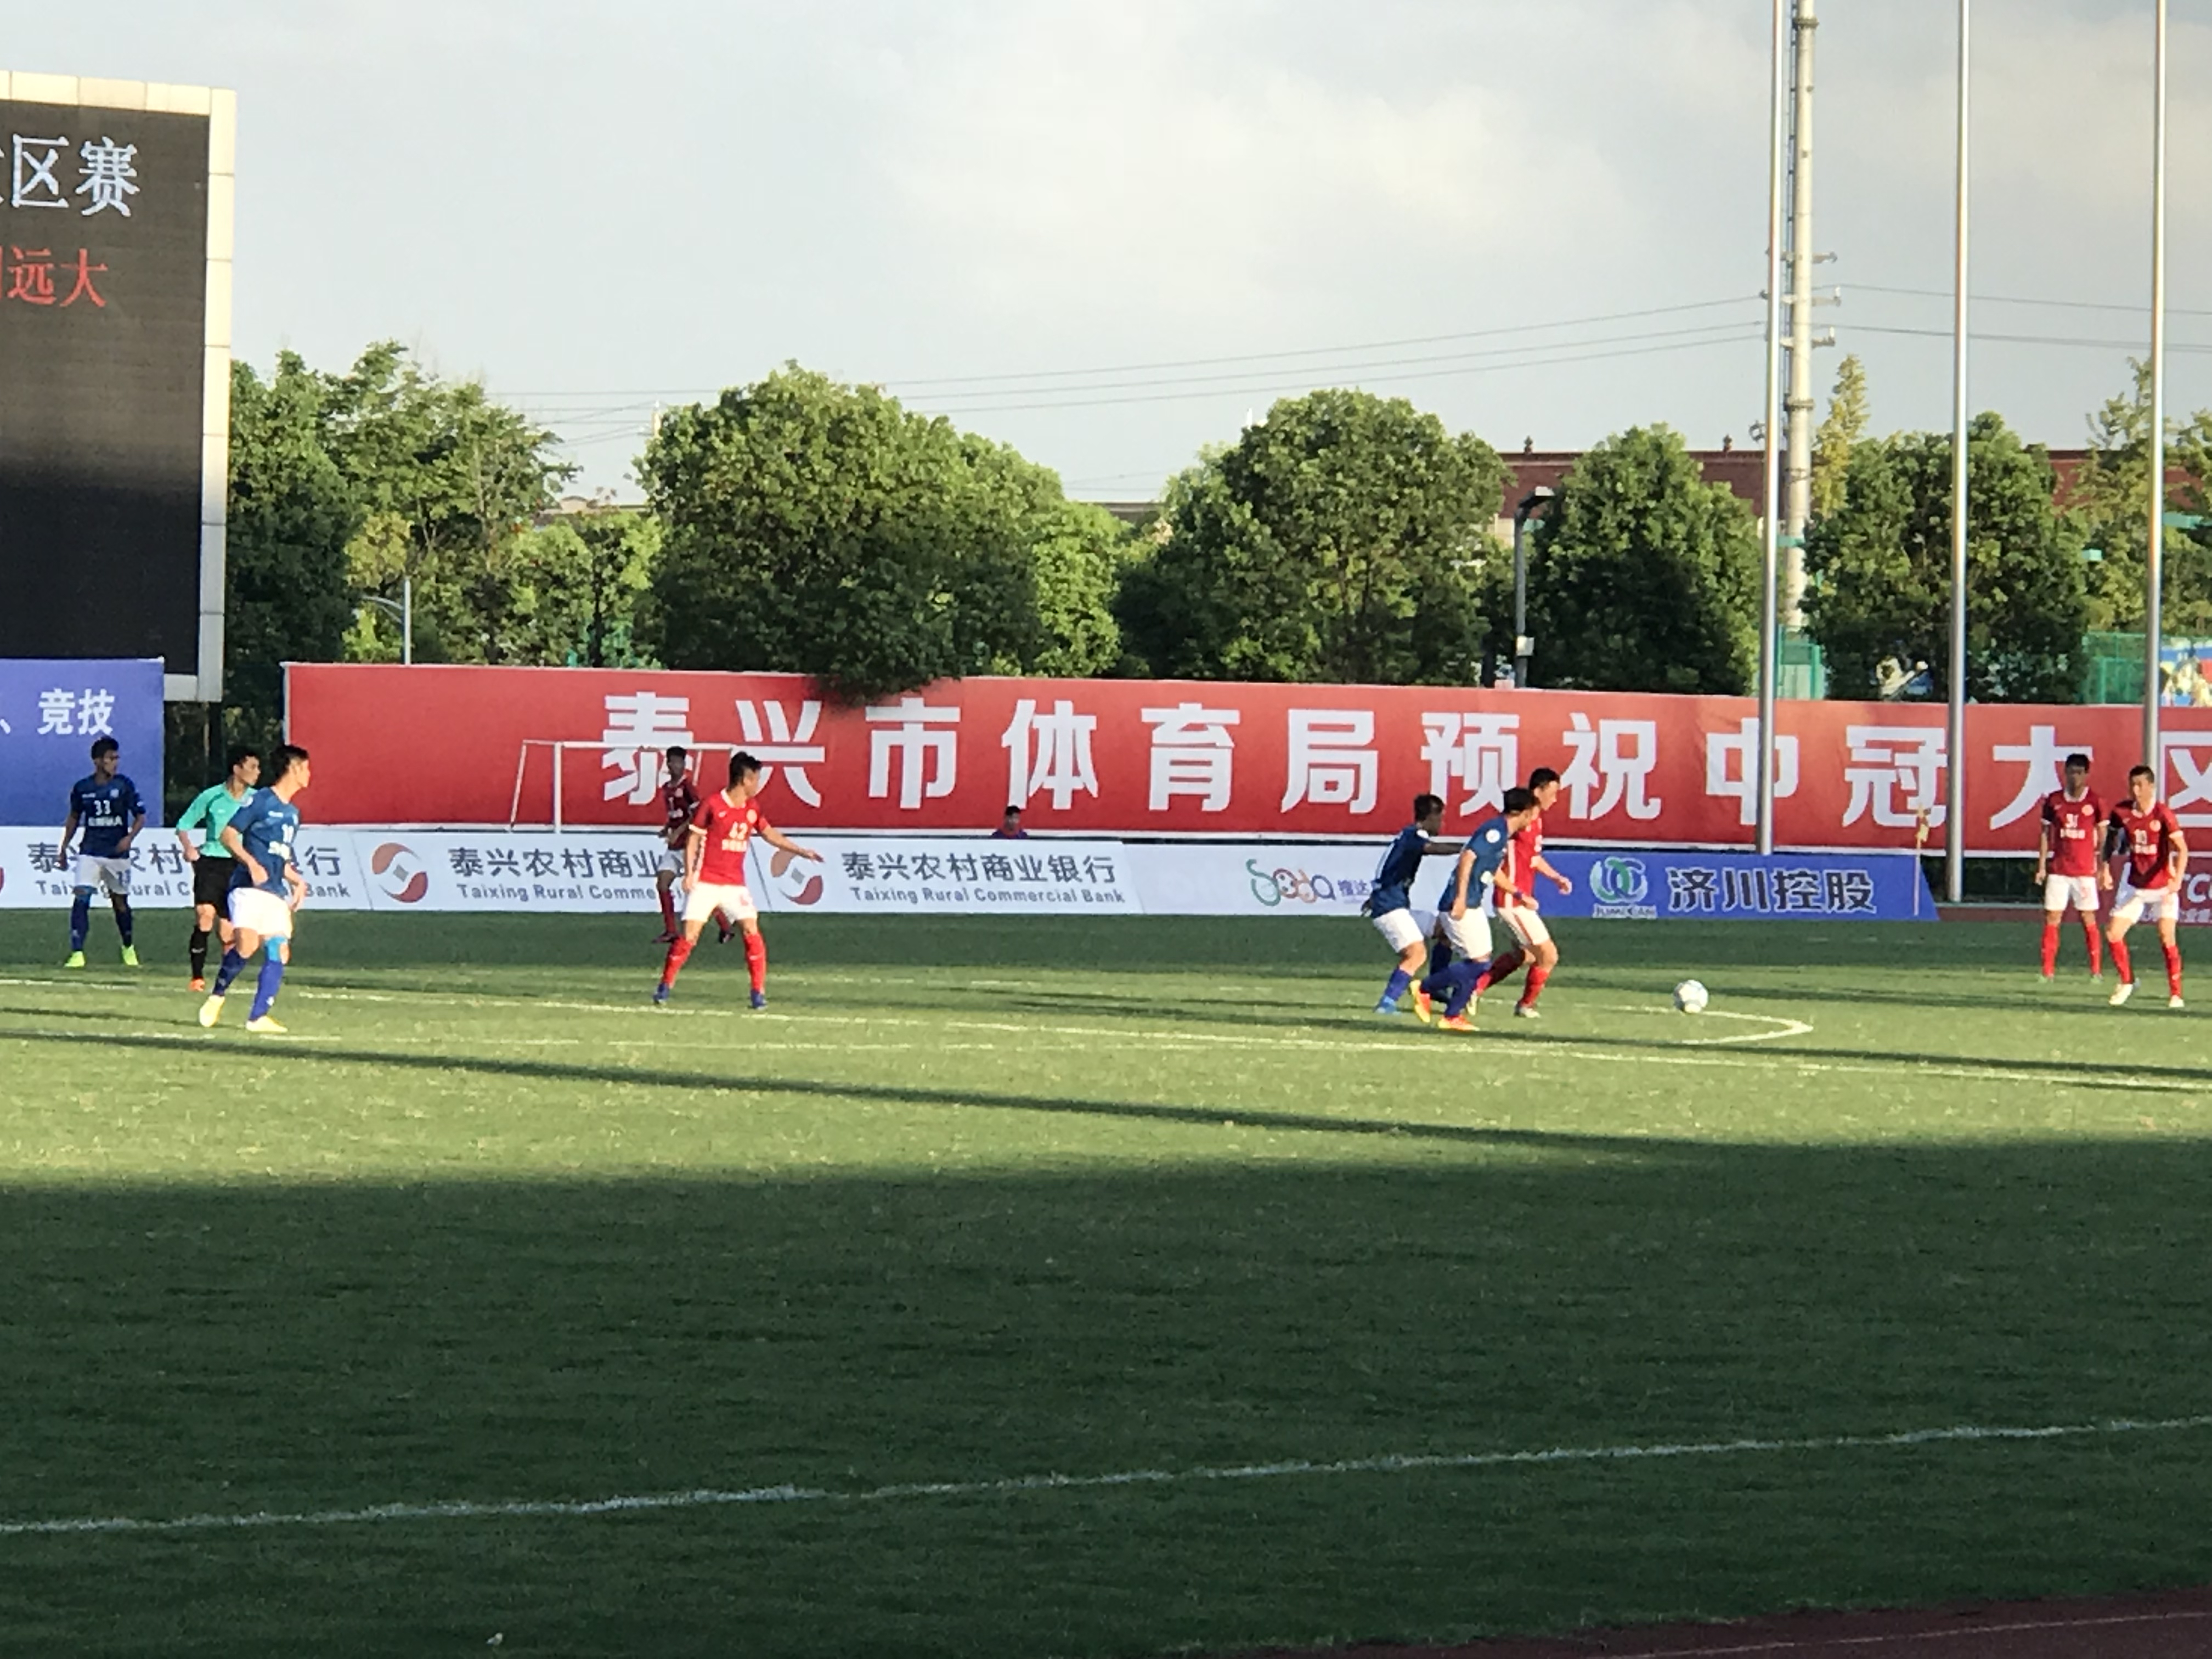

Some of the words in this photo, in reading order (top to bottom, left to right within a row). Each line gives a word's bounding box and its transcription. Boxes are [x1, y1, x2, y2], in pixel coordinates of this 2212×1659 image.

[0, 133, 140, 217] 区赛
[0, 245, 108, 307] 远大
[448, 848, 684, 878] 泰兴农村商业
[842, 852, 1115, 883] 泰兴农村商业银行
[127, 880, 171, 896] ural
[457, 884, 528, 901] Taixing
[534, 884, 582, 899] Rural
[850, 887, 918, 904] Taixing
[923, 888, 969, 901] Rural
[974, 888, 1077, 903] Commercial
[1083, 889, 1125, 903] Bank
[1666, 867, 1877, 914] 济川控股
